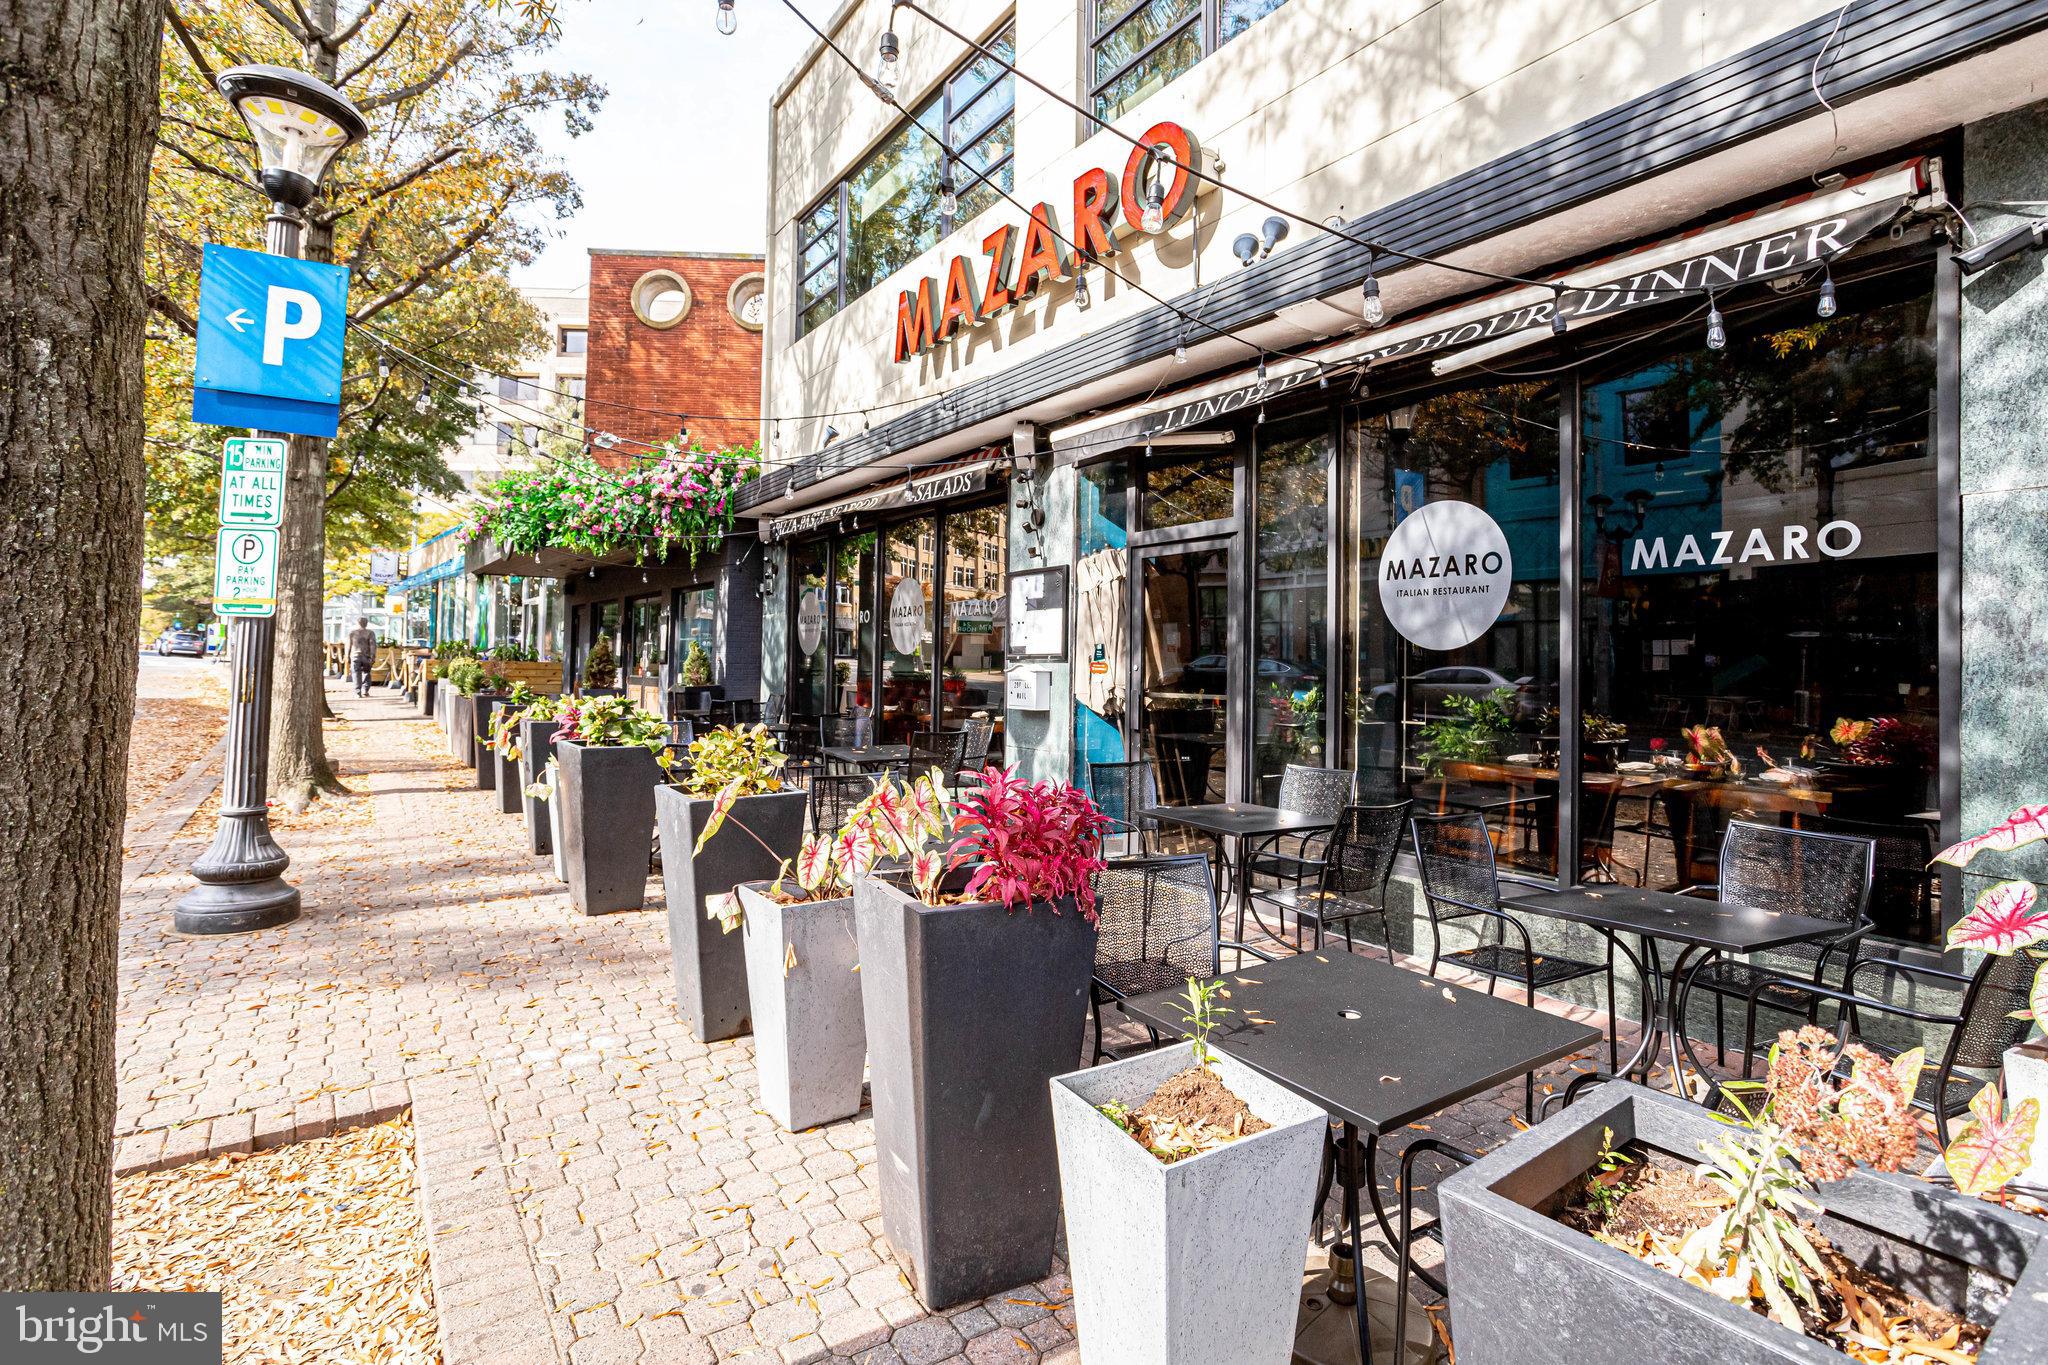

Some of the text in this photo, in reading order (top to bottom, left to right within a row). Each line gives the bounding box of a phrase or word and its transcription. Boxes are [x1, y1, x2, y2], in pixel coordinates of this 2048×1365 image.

[894, 121, 1202, 364] MAZARO
[262, 284, 322, 366] P
[227, 444, 244, 467] 15
[255, 445, 272, 455] MIN
[245, 457, 281, 469] PARKING
[230, 476, 276, 490] AT ALL
[233, 493, 272, 508] TIMES
[243, 539, 255, 559] P
[1631, 520, 1862, 570] MAZARO
[237, 565, 255, 575] PAY
[1386, 551, 1503, 581] MAZARO
[226, 575, 266, 586] PARKING
[233, 587, 241, 600] 2
[1396, 585, 1490, 597] ITALIAN RESTAURANT
[892, 604, 923, 618] MAZARO
[950, 599, 998, 616] MAZARO
